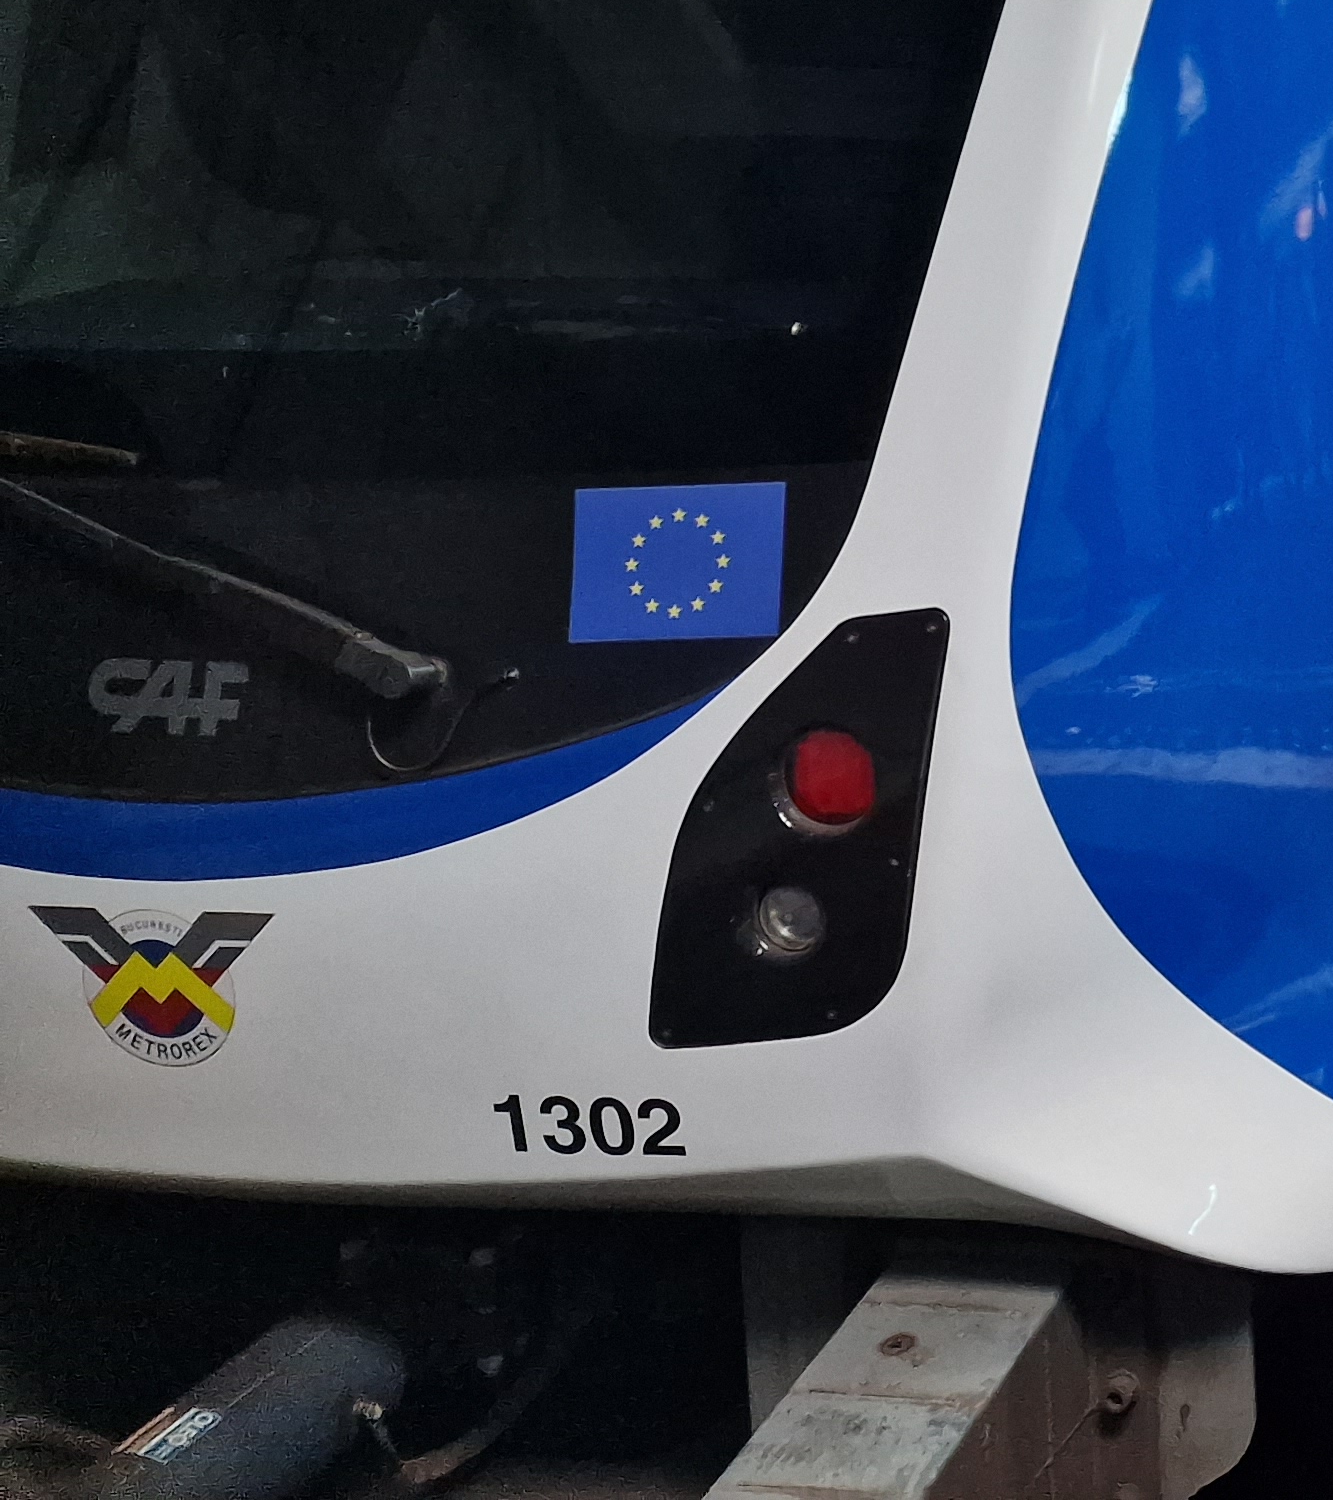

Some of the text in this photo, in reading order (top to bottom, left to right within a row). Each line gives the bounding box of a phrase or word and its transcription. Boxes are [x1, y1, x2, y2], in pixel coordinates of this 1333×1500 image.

[88, 657, 249, 736] CAF
[115, 1022, 218, 1060] METROREX
[493, 1094, 687, 1156] 1302
